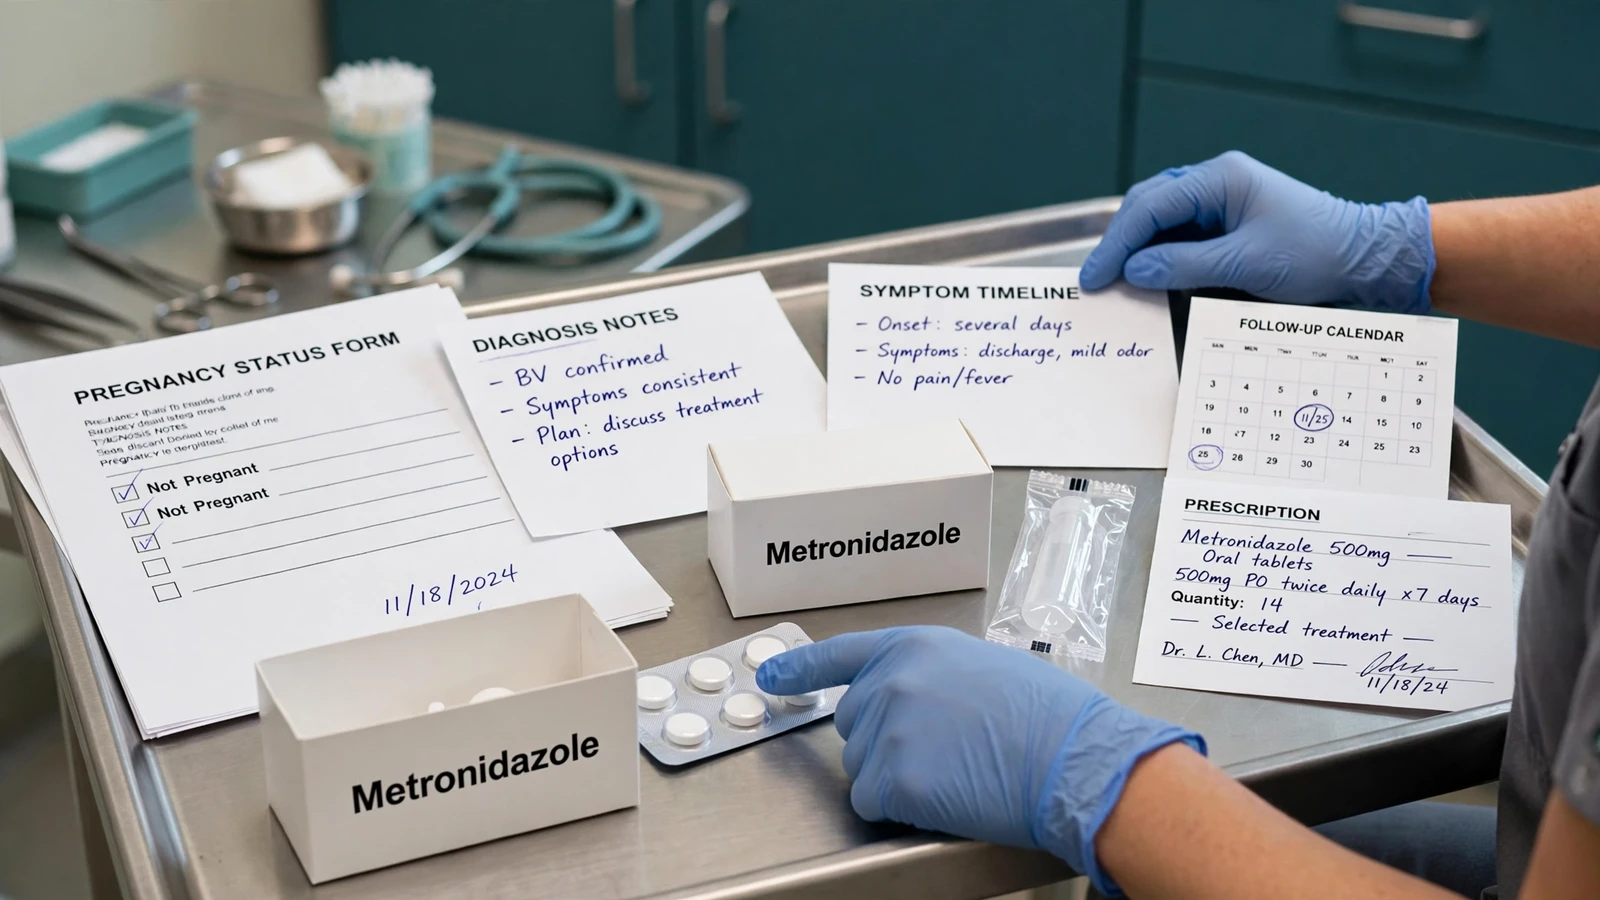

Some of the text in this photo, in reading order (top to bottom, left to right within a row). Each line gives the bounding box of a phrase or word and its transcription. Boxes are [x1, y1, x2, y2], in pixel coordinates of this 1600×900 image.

[860, 284, 1080, 300] SYMPTOM TIMELINE
[472, 307, 680, 353] DIAGNOSIS NOTES
[954, 315, 1018, 332] several
[1030, 315, 1073, 338] days
[1239, 317, 1405, 343] FOLLOW-UP CALENDAR
[514, 343, 669, 387] BV confirmed
[877, 342, 1154, 364] Symptoms: discharge, mild odor
[73, 363, 227, 405] PREGNANCY
[234, 346, 327, 375] STATUS
[330, 331, 401, 356] FORM
[877, 366, 1014, 391] No pain/fever
[1384, 371, 1424, 382] 1 2
[526, 362, 743, 420] Symptoms consistent
[1209, 379, 1422, 406] 3 4 5 6 7 8 9
[536, 387, 765, 446] Plan: discuss treatment
[1205, 403, 1283, 418] 19 10 11
[1301, 407, 1330, 428] 11/25
[1342, 416, 1423, 431] 14 15 10
[550, 442, 619, 472] options
[1270, 433, 1281, 442] 12
[1303, 436, 1315, 445] 23
[1338, 439, 1350, 448] 24
[1373, 442, 1385, 451] 25
[1409, 445, 1421, 454] 23
[1197, 450, 1209, 459] 25
[1266, 456, 1278, 465] 29
[1300, 460, 1313, 468] 30
[147, 462, 260, 495] Not Pregnant
[157, 487, 270, 520] Not Pregnant
[1184, 498, 1321, 522] PRESCRIPTION
[766, 522, 961, 566] Metronidazole
[1180, 528, 1392, 568] Metronidazole 500mg
[1202, 548, 1313, 572] Oral tablets
[385, 563, 518, 617] 11/18/2024
[1171, 590, 1284, 613] Quantity: 14
[1174, 566, 1232, 590] 500mg
[1245, 572, 1269, 589] PO
[1281, 577, 1329, 595] twice
[1341, 580, 1388, 607] daily
[1438, 588, 1481, 613] days
[1212, 614, 1394, 643] Selected treatment
[1162, 640, 1304, 669] Dr. L. Chen, MD
[1366, 676, 1449, 696] 11/18/24
[351, 732, 600, 815] Metronidazole
